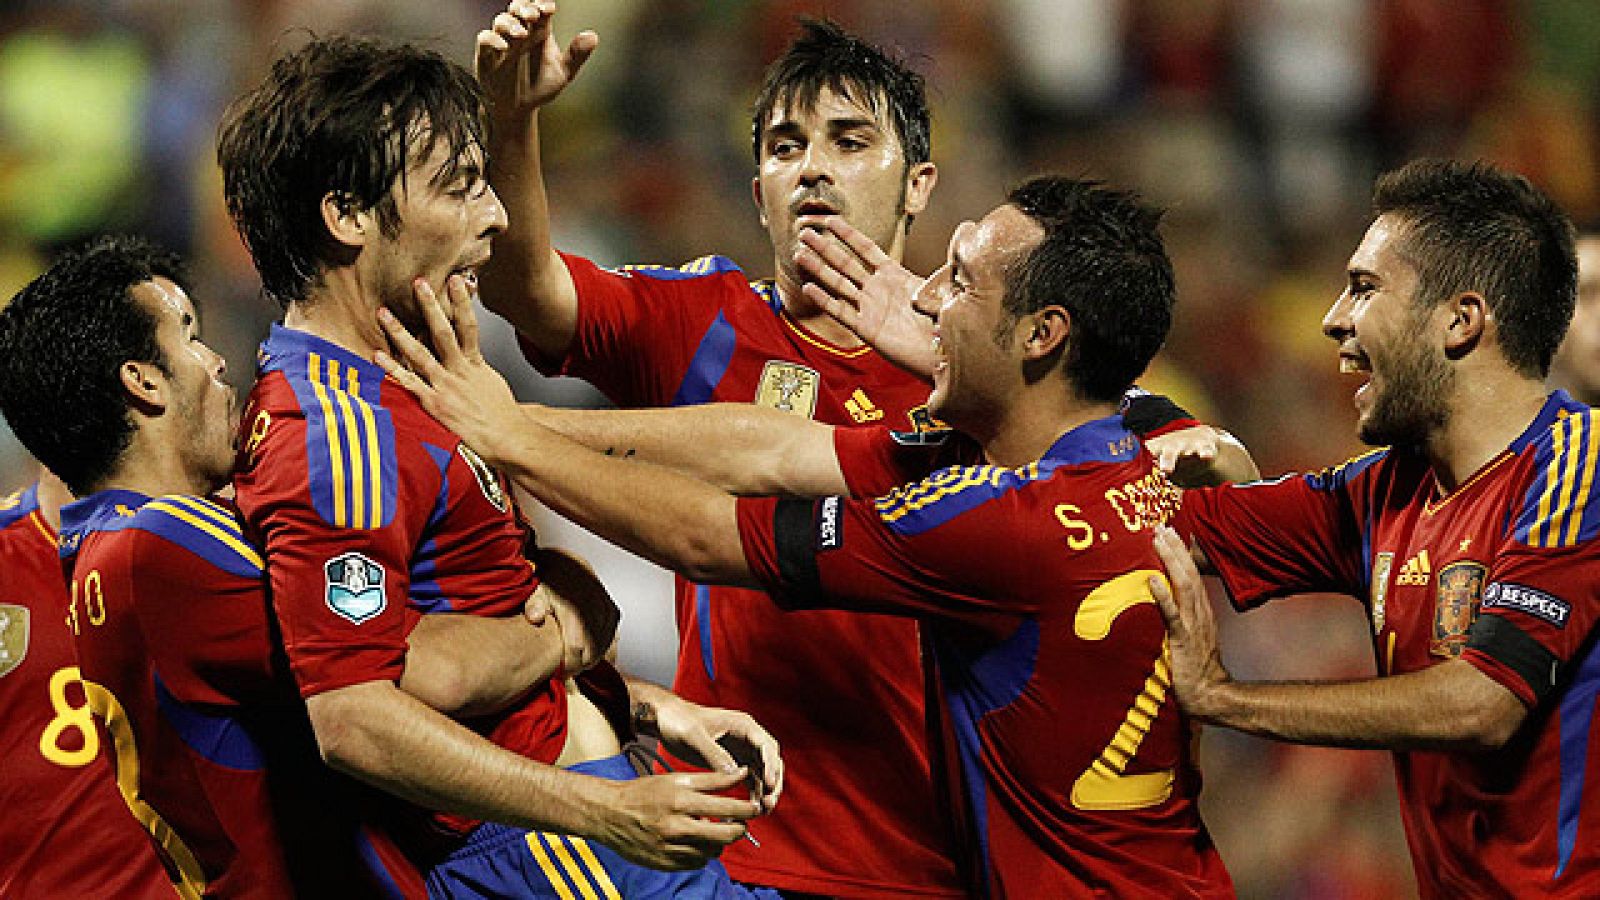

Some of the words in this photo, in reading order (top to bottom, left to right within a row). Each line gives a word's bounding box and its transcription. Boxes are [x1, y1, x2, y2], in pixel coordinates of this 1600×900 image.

[1054, 504, 1109, 551] S.
[1500, 587, 1569, 622] RESPECT
[40, 666, 99, 768] 8
